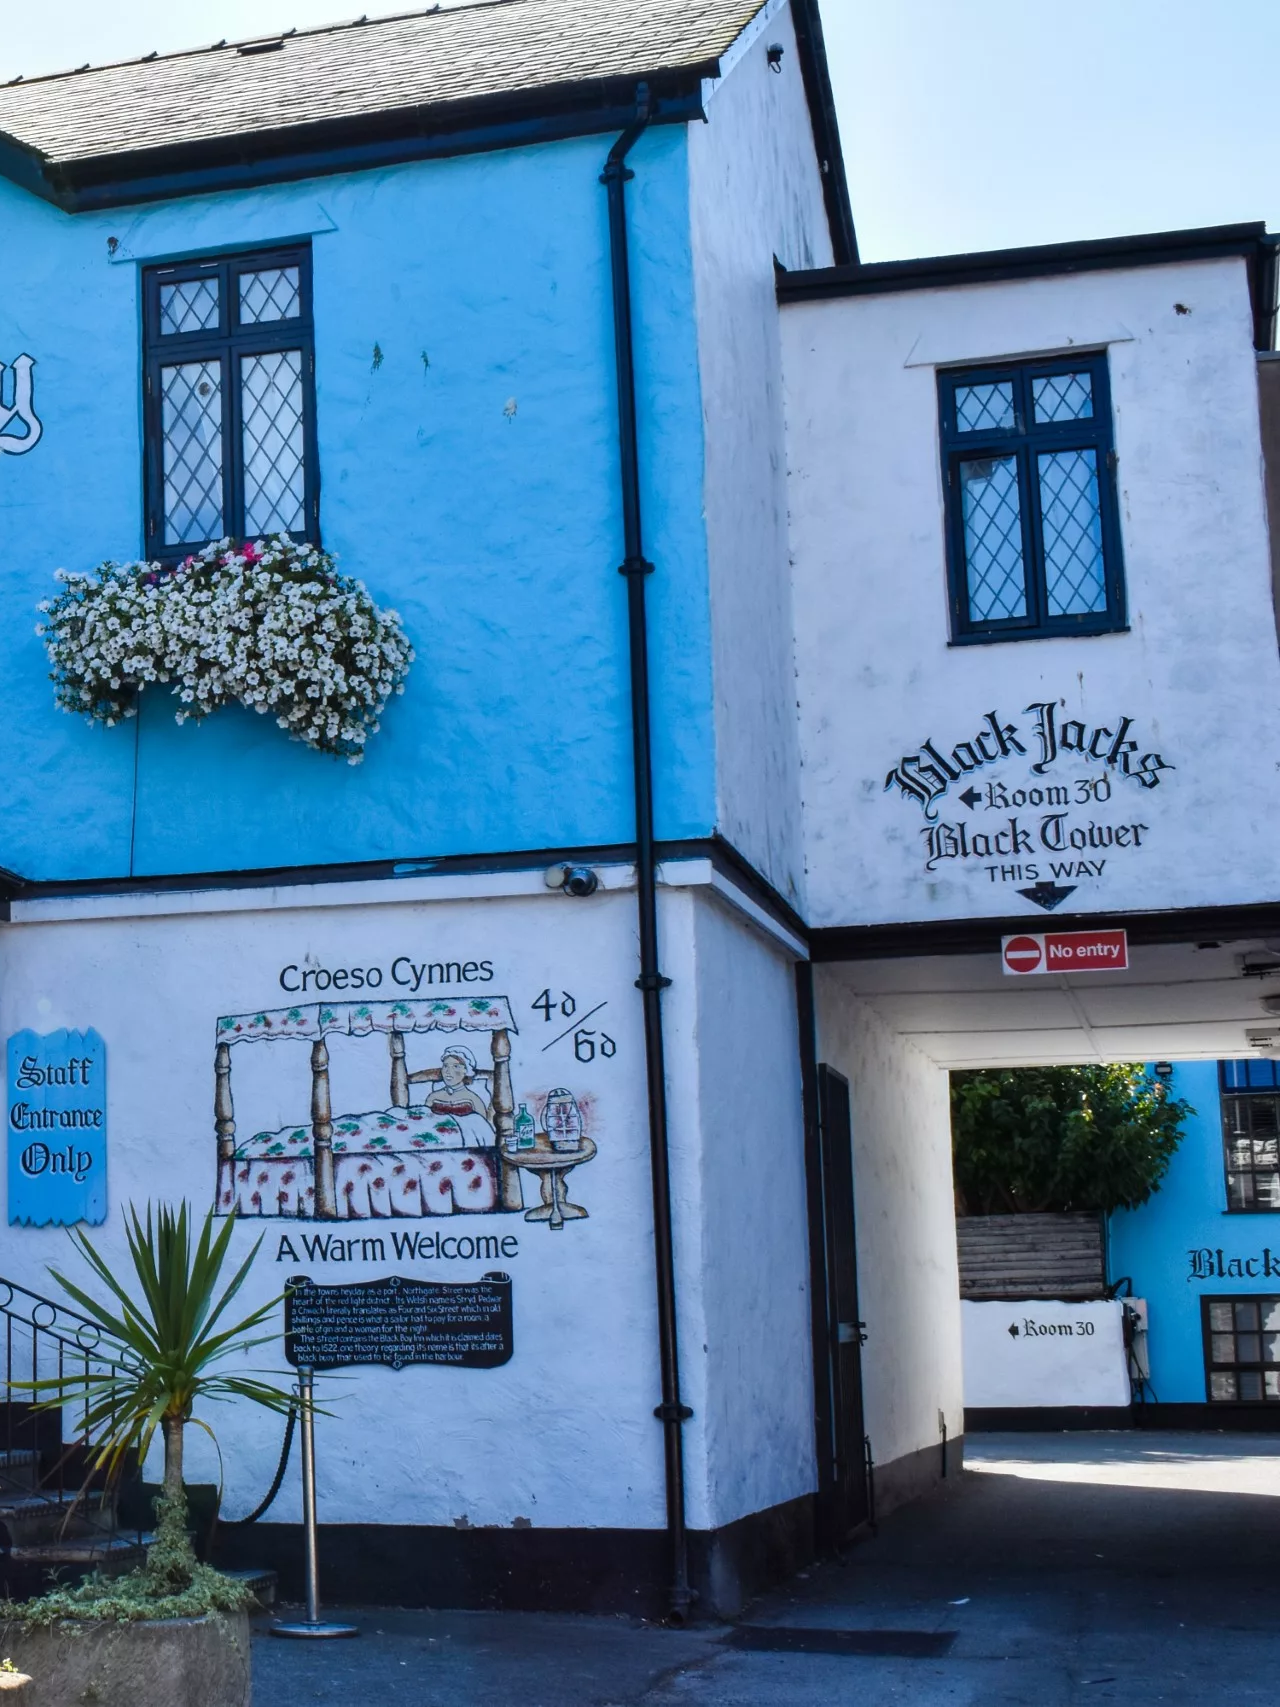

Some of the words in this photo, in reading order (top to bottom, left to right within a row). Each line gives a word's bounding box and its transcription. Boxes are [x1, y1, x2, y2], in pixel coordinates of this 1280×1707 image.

[883, 709, 1027, 822] Black
[1022, 700, 1176, 790] Jacks
[984, 781, 1070, 811] Room
[1074, 779, 1112, 805] 30
[920, 818, 1036, 871] Black
[1039, 812, 1149, 852] Tower
[984, 862, 1040, 883] THIS
[1049, 859, 1107, 879] WAY
[1049, 944, 1073, 958] No
[1076, 943, 1120, 958] entry
[279, 964, 383, 993] Croeso
[391, 956, 495, 993] Cynnes
[16, 1055, 94, 1089] Staff
[10, 1101, 104, 1131] Entrance
[21, 1142, 94, 1184] Only
[275, 1234, 301, 1262] A
[300, 1233, 386, 1262] Warm
[390, 1231, 519, 1260] Welcome
[1186, 1247, 1280, 1283] Black
[292, 1297, 314, 1306] heart
[315, 1296, 323, 1305] of
[325, 1297, 336, 1305] the
[337, 1297, 350, 1305] red
[350, 1297, 365, 1307] light
[405, 1295, 428, 1304] Welsh
[429, 1296, 449, 1304] name
[341, 1287, 366, 1298] heyday
[402, 1286, 439, 1297] Northgate
[442, 1286, 463, 1295] Street
[464, 1286, 479, 1294] was
[480, 1285, 492, 1294] the
[292, 1315, 321, 1325] shillings
[321, 1315, 335, 1324] and
[336, 1316, 358, 1326] pence
[358, 1316, 365, 1324] is
[365, 1315, 382, 1324] what
[389, 1315, 409, 1324] sailor
[410, 1314, 423, 1323] had
[424, 1314, 432, 1323] to
[433, 1315, 446, 1325] pay
[446, 1313, 457, 1322] for
[352, 1305, 387, 1315] translates
[397, 1305, 413, 1314] Four
[413, 1305, 426, 1314] and
[437, 1304, 459, 1314] Street
[460, 1304, 481, 1313] which
[482, 1304, 490, 1313] in
[490, 1303, 501, 1312] old
[300, 1334, 315, 1343] The
[368, 1334, 379, 1342] the
[379, 1333, 399, 1343] Black
[399, 1333, 413, 1344] Boy
[413, 1333, 425, 1342] Inn
[425, 1332, 444, 1342] which
[457, 1332, 484, 1341] claimed
[485, 1331, 503, 1341] dates
[314, 1324, 322, 1333] of
[322, 1325, 333, 1335] gin
[334, 1324, 347, 1333] and
[381, 1323, 393, 1333] for
[394, 1323, 408, 1333] the
[1022, 1317, 1074, 1338] Room
[1075, 1321, 1095, 1336] 30
[293, 1343, 311, 1353] back
[311, 1343, 320, 1352] to
[340, 1344, 354, 1352] one
[354, 1343, 379, 1353] theory
[380, 1342, 415, 1355] regarding
[427, 1343, 448, 1352] name
[448, 1342, 455, 1351] is
[455, 1341, 469, 1351] that
[479, 1340, 496, 1350] after
[498, 1341, 504, 1350] a
[297, 1353, 317, 1362] black
[336, 1353, 351, 1361] that
[353, 1352, 373, 1361] used
[373, 1352, 382, 1361] to
[383, 1352, 392, 1361] be
[394, 1351, 414, 1361] found
[414, 1352, 422, 1361] in
[422, 1352, 434, 1360] the
